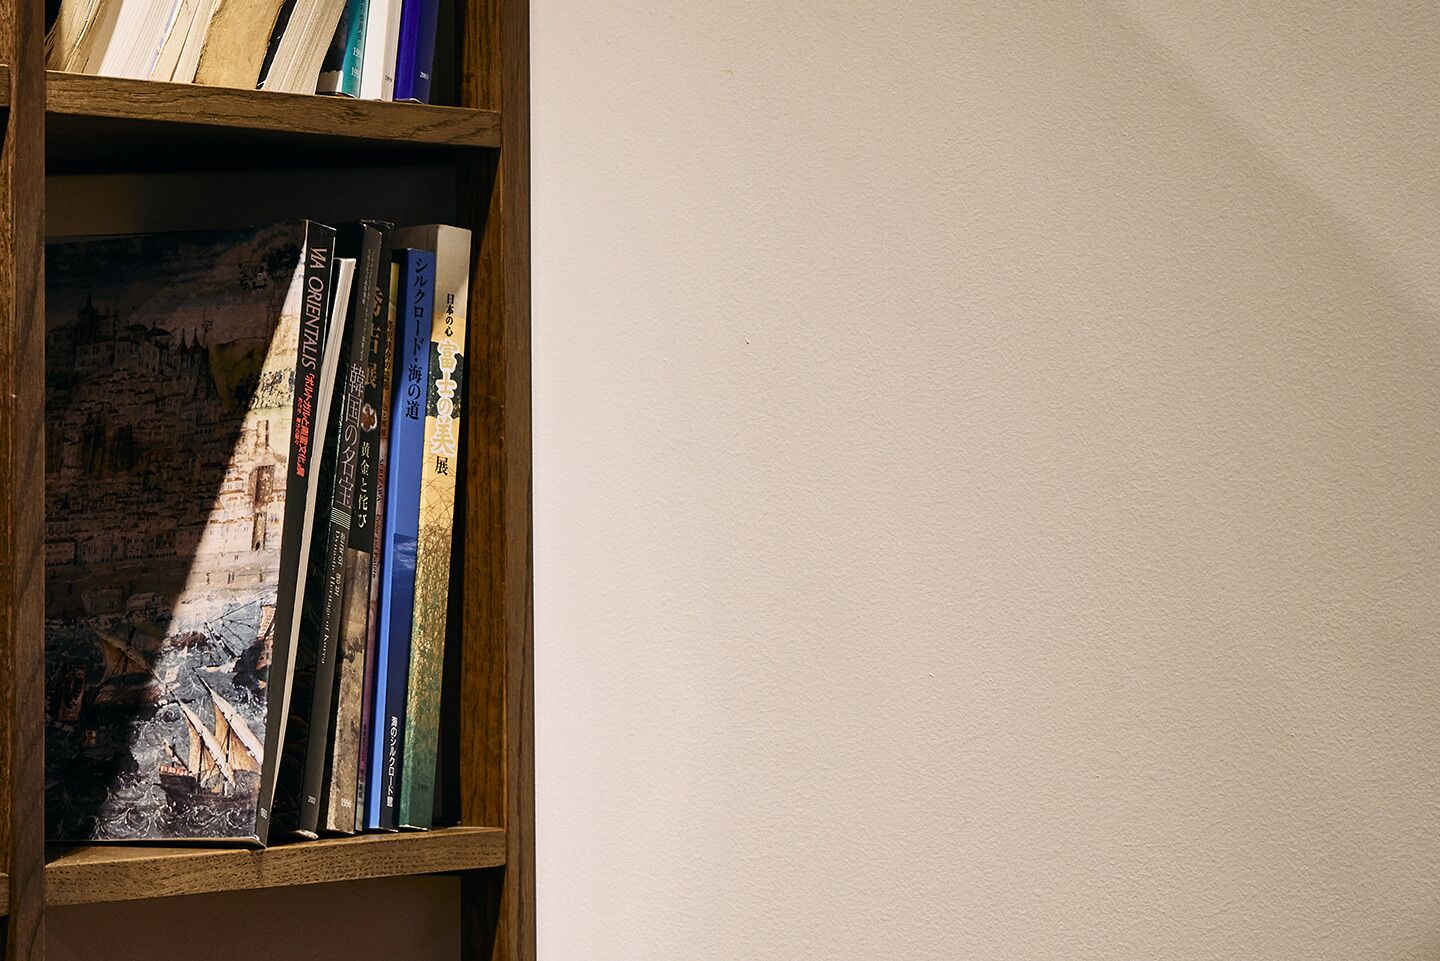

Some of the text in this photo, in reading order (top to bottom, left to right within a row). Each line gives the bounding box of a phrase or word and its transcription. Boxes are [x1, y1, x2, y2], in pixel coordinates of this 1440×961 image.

[301, 247, 328, 370] VIA ORIENTALIS
[405, 257, 429, 420] シルクロード・海の道
[333, 363, 366, 509] 韓国の名宝
[356, 440, 372, 529] 黄金と侘び
[331, 529, 341, 573] Dynastic
[326, 575, 336, 619] Heritage
[320, 633, 330, 664] Korea
